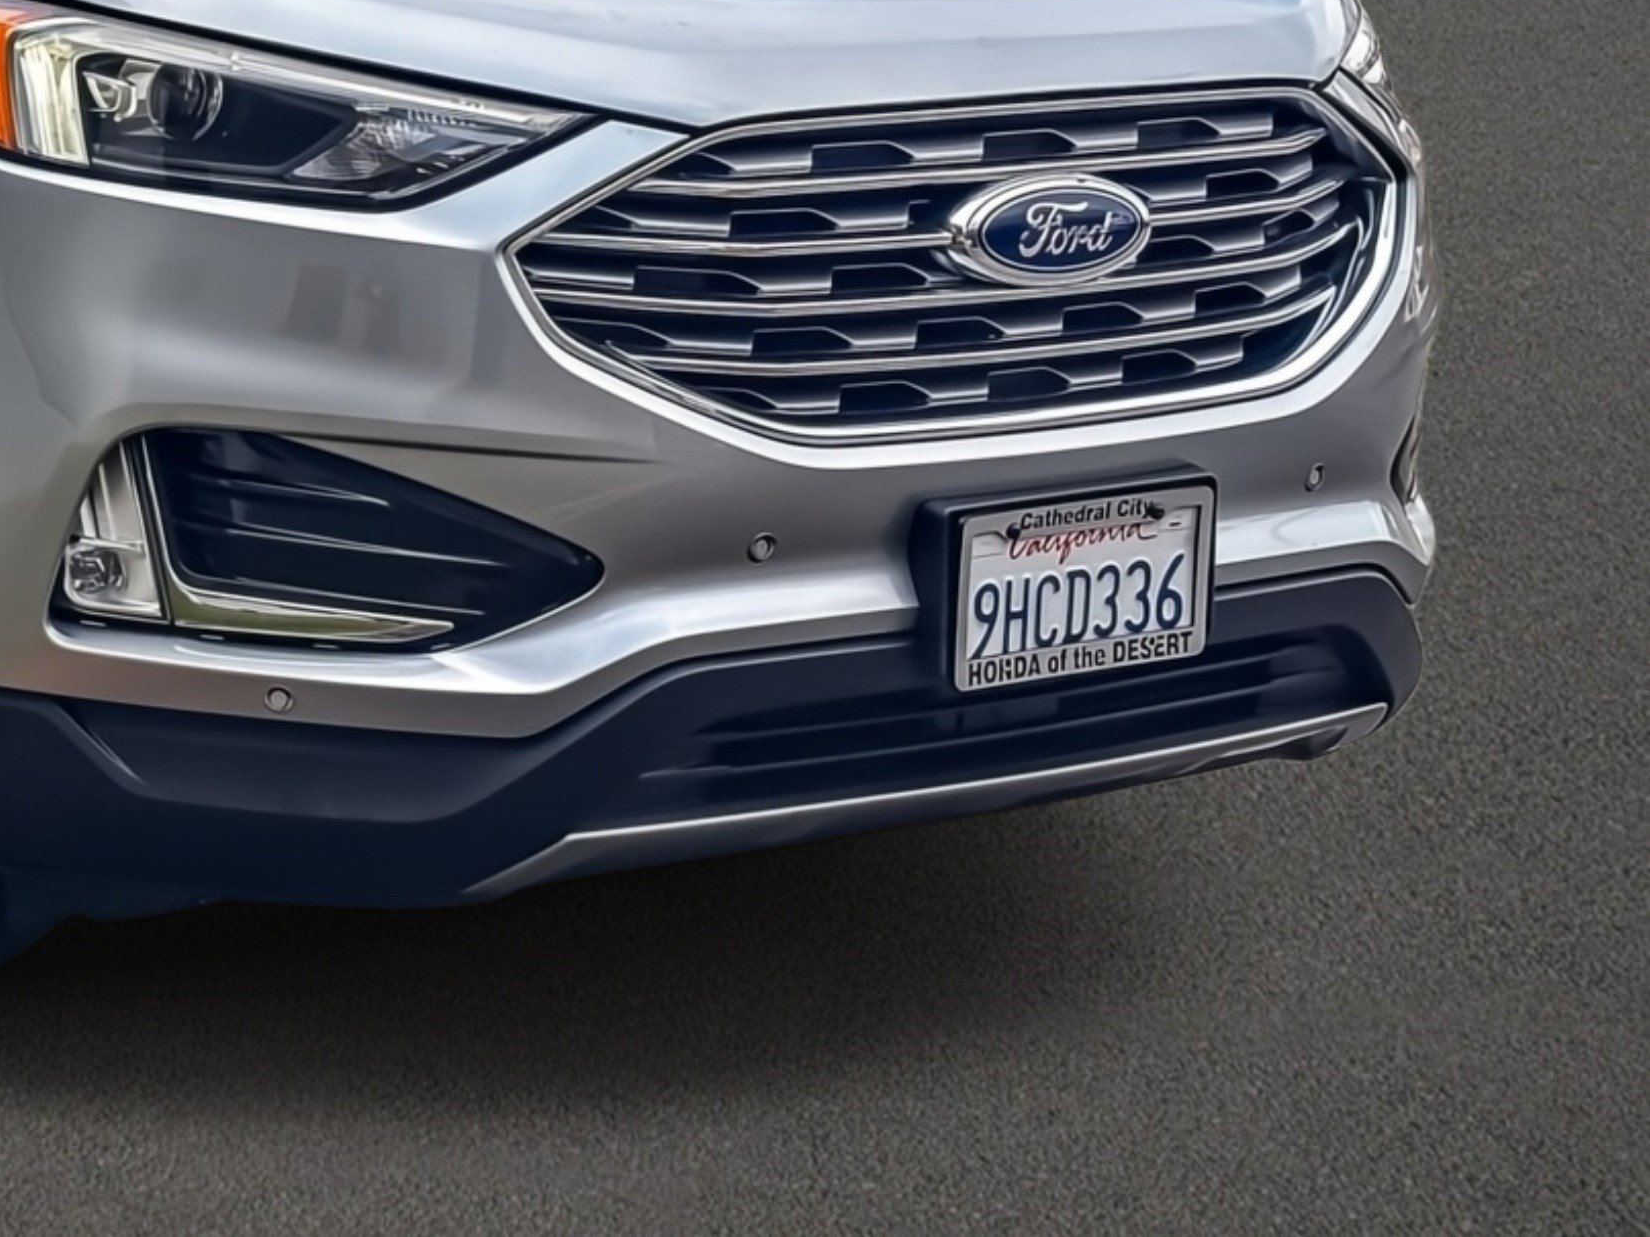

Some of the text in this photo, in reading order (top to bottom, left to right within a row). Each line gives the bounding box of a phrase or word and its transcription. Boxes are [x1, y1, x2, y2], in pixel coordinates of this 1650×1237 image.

[1018, 200, 1113, 258] Ford
[1020, 497, 1151, 530] Cathedral City
[970, 552, 1186, 660] 9HCD336
[967, 631, 1193, 687] HONDA of the DESERT
